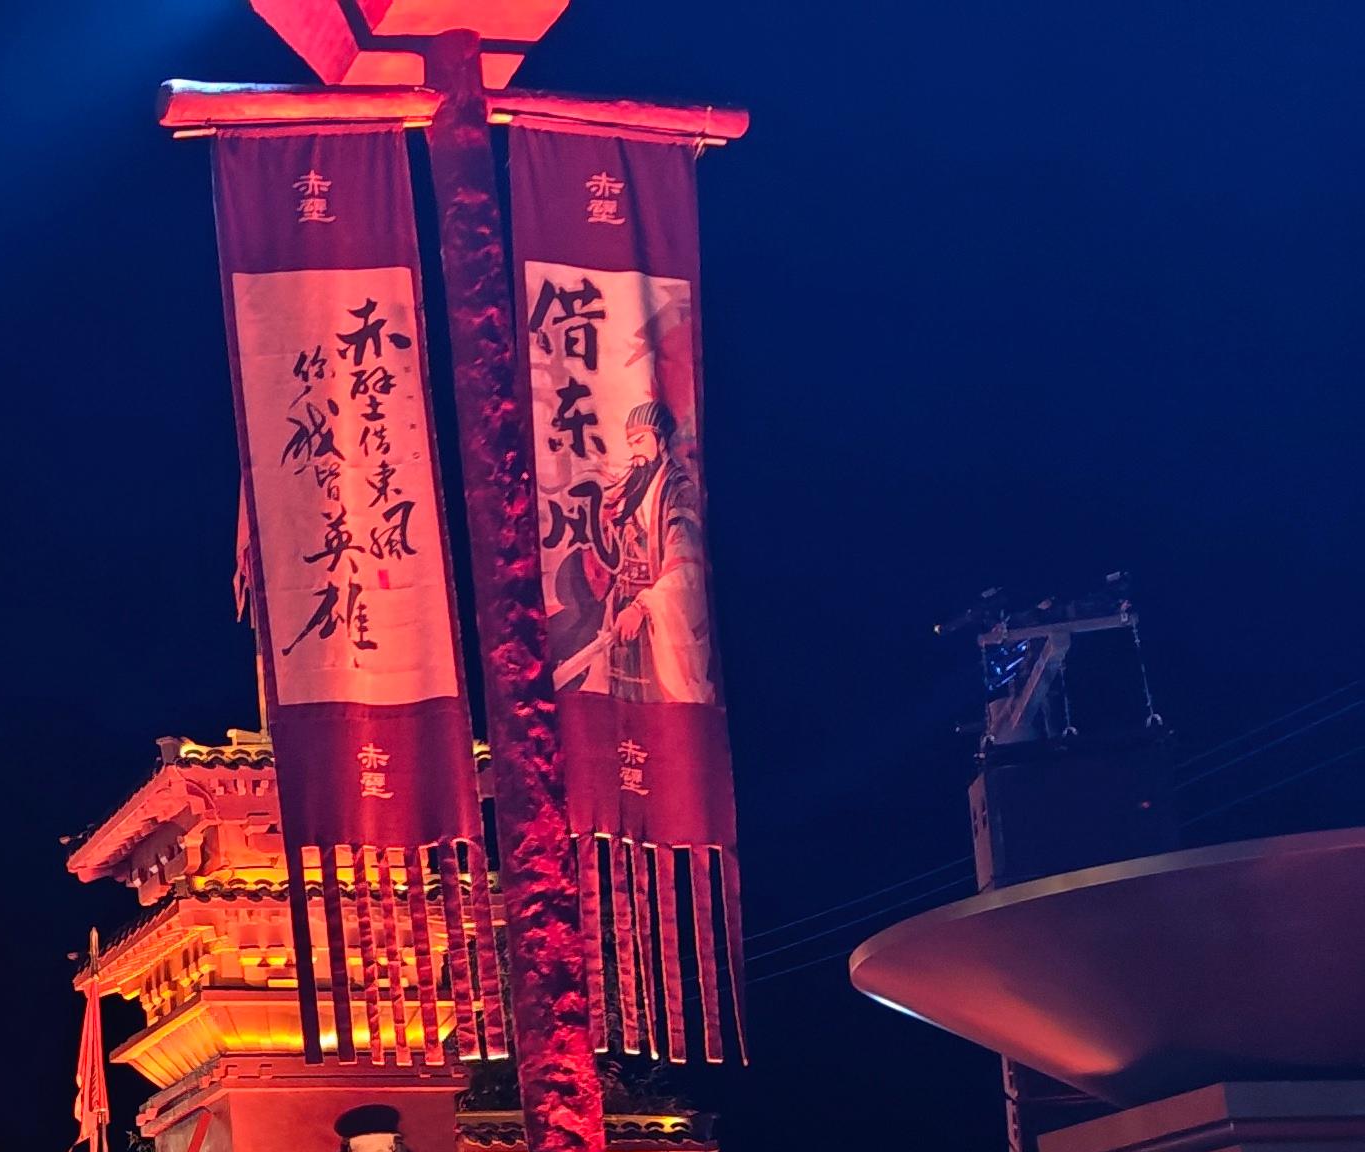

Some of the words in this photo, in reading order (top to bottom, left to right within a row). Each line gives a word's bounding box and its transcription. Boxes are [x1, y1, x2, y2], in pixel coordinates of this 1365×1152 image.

[291, 170, 336, 223] 赤壁
[584, 171, 626, 225] 赤壁
[530, 277, 622, 570] 借东风
[355, 742, 395, 799] 赤壁
[617, 738, 652, 798] 赤壁
